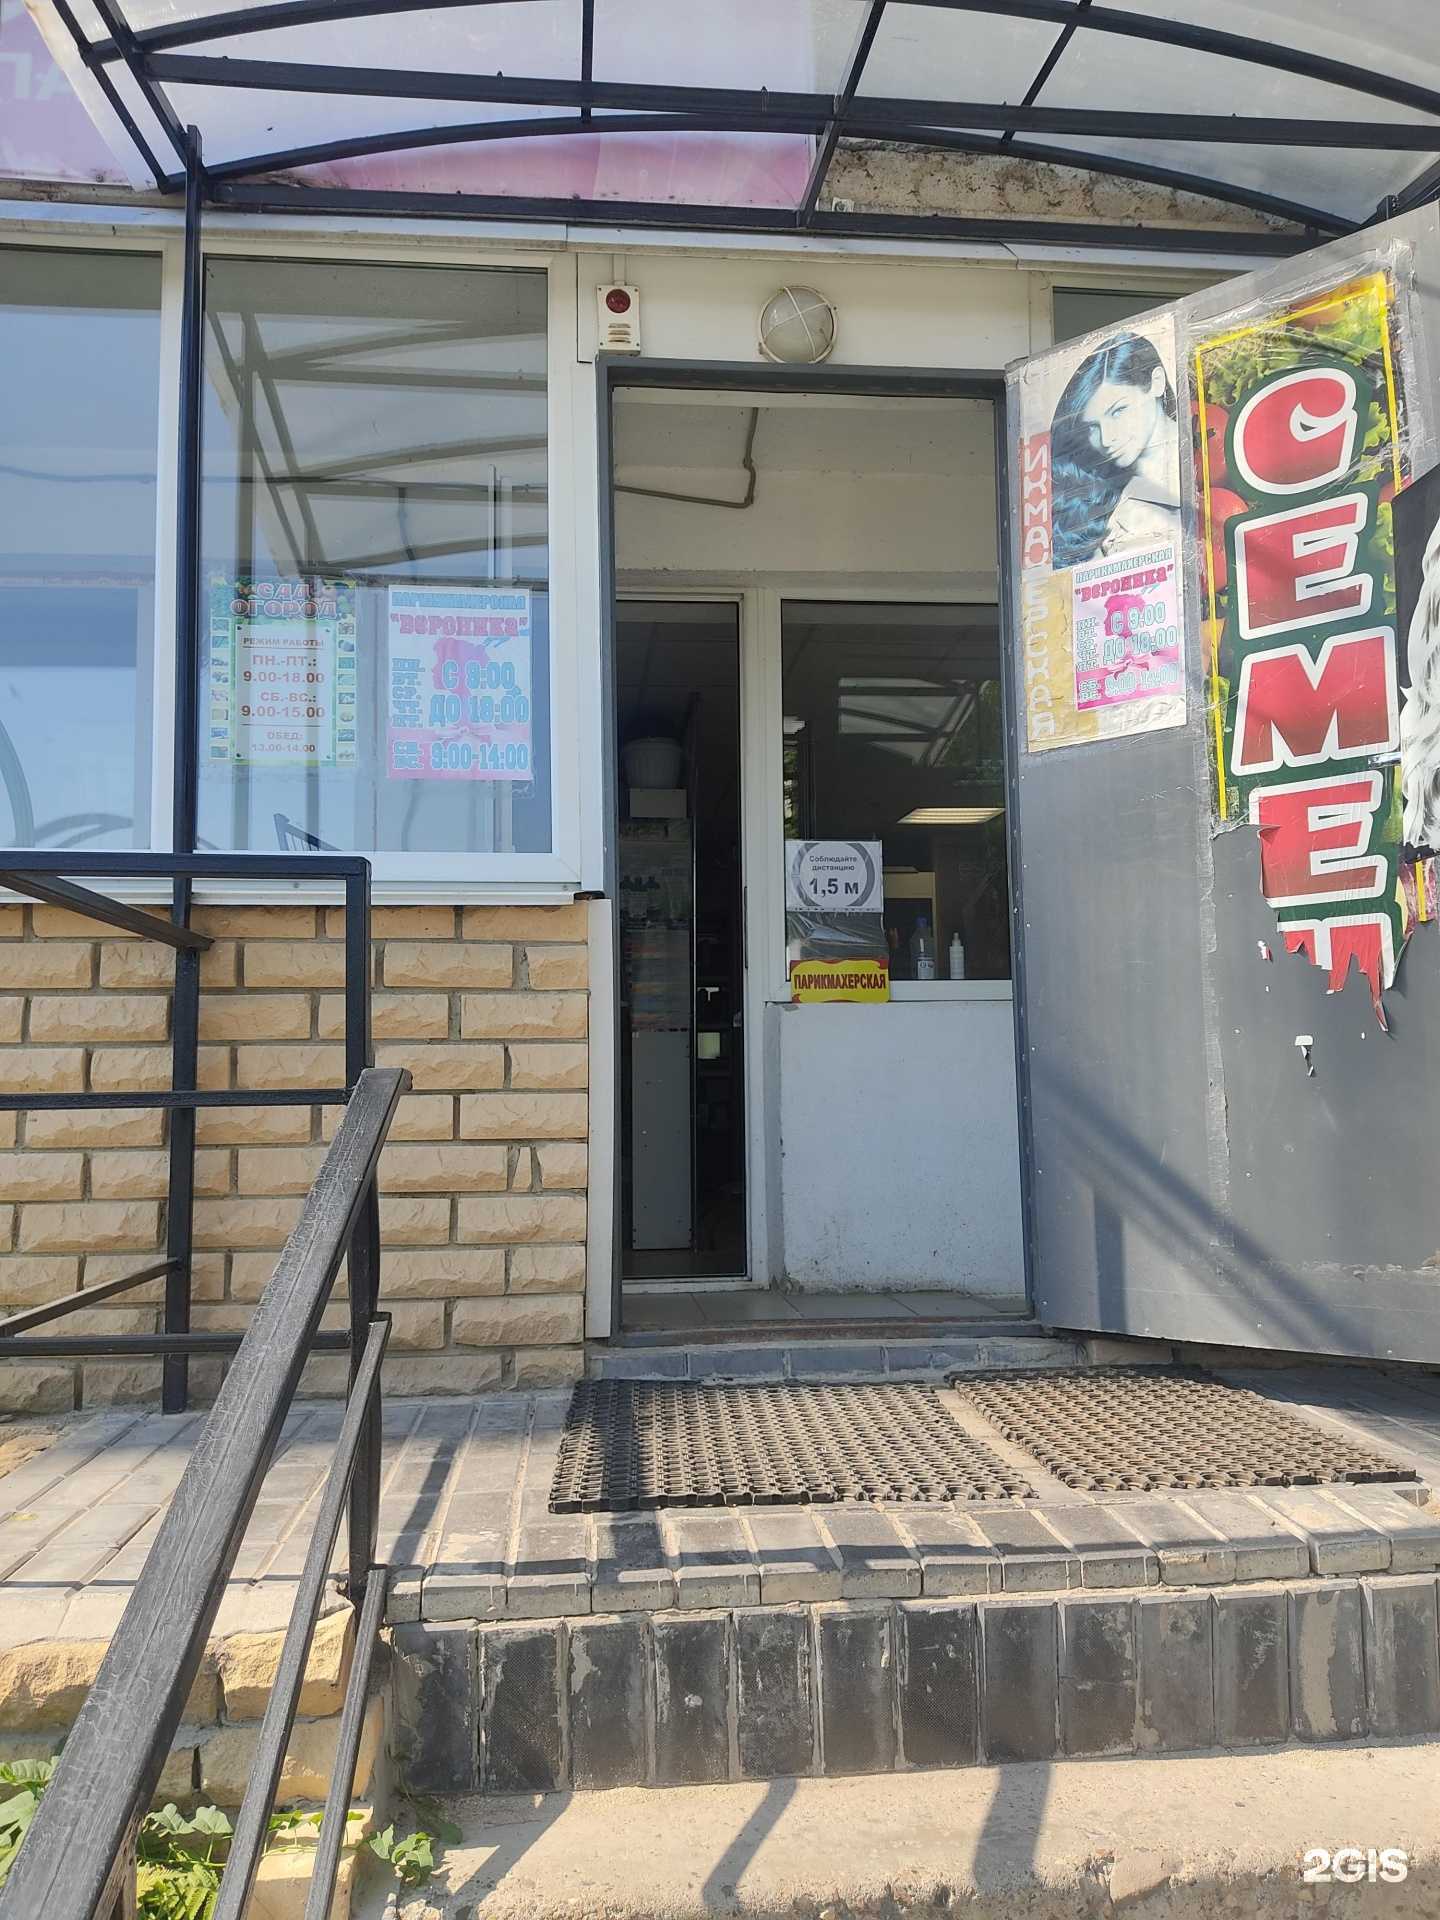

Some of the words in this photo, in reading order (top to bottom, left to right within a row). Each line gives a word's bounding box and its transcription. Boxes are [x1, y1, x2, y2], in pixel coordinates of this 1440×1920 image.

[256, 582, 312, 602] САД
[230, 598, 339, 621] ОГОРОД
[243, 637, 281, 647] РЕЖИМ
[282, 638, 325, 647] РАБОТЫ
[1103, 637, 1126, 666] ДО
[1130, 625, 1178, 655] 18:00
[243, 670, 325, 684] 9.00-18.00
[443, 660, 458, 690] С
[241, 704, 325, 718] 9.00-15.00
[429, 694, 460, 728] ДО
[469, 694, 530, 723] 18:00
[431, 742, 529, 770] 9:00-14:00
[809, 855, 858, 864] Соблюдайте
[811, 864, 856, 872] дистанцию
[809, 878, 839, 898] 1,5
[794, 973, 887, 990] ПАРИКМАХЕРСКАЯ
